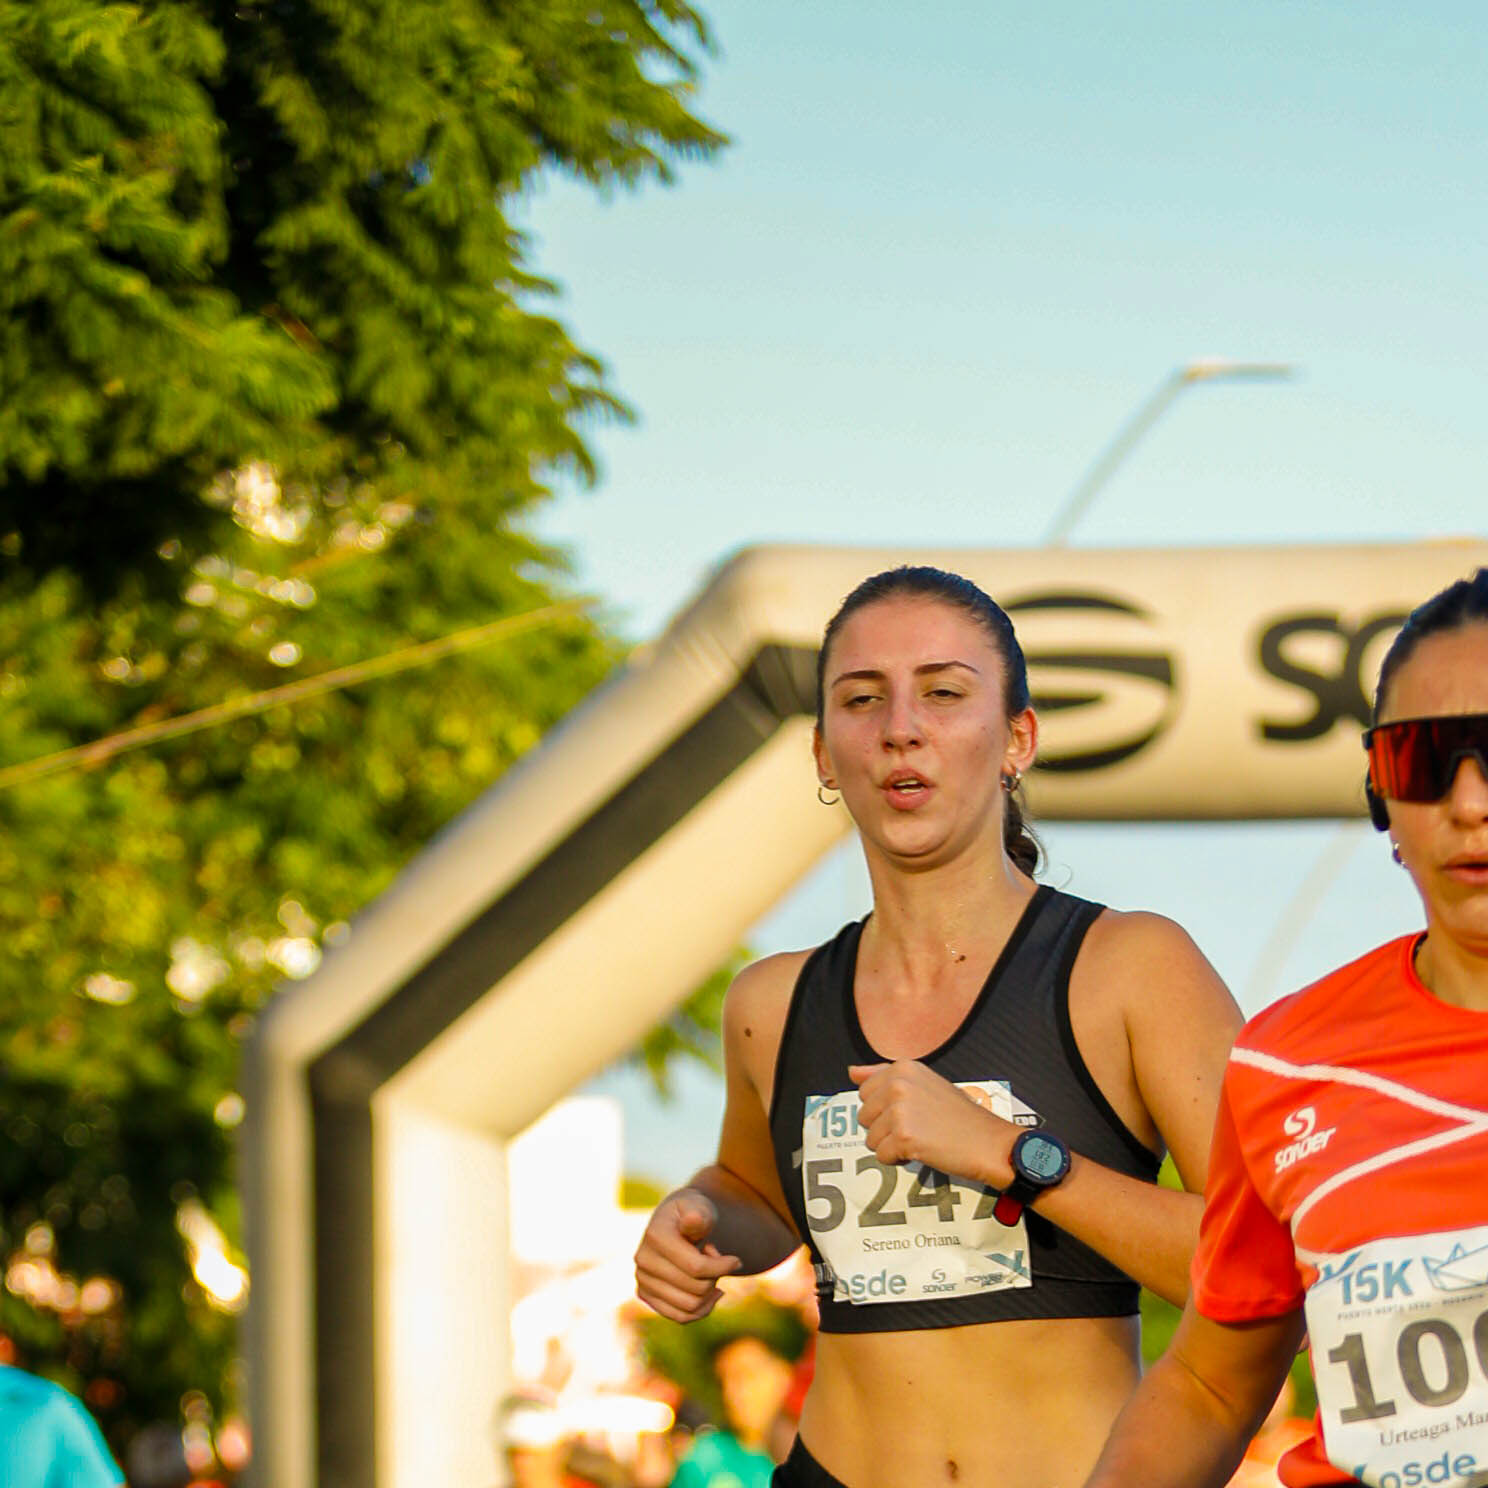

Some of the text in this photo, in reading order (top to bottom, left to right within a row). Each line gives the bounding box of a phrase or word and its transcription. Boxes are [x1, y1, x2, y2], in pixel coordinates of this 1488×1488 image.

[862, 1232, 961, 1252] Sereno Oriana
[1338, 1258, 1414, 1305] 15K
[1379, 1420, 1450, 1447] Urteaga
